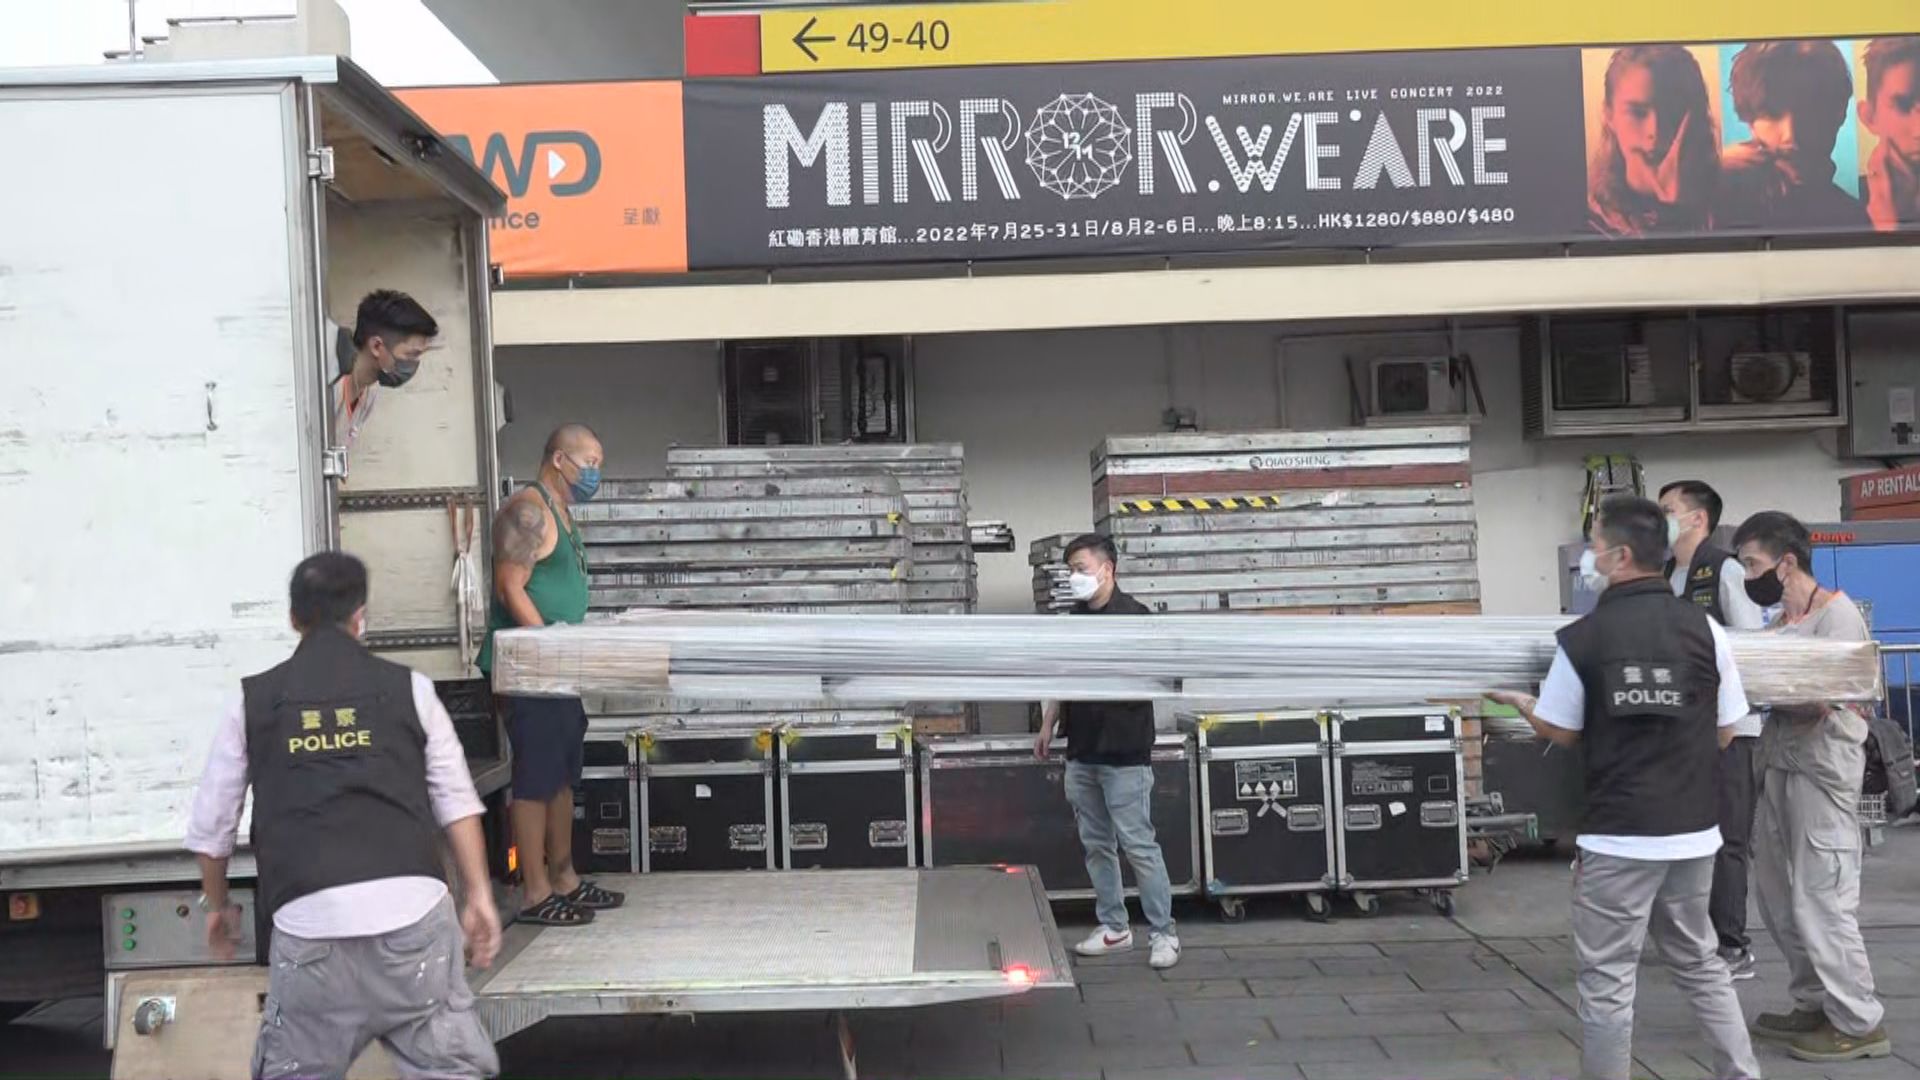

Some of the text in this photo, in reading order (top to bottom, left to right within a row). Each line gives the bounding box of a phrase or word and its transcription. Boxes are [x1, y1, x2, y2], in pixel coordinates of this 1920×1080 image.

[847, 20, 950, 53] 49-40
[1346, 88, 1379, 101] LIVE
[1390, 86, 1454, 99] CONCERT
[1466, 86, 1504, 97] 2022
[441, 131, 602, 198] WD
[490, 211, 540, 230] nce
[1861, 479, 1875, 499] AP
[1613, 688, 1682, 706] POLICE
[288, 730, 371, 754] POLICE
